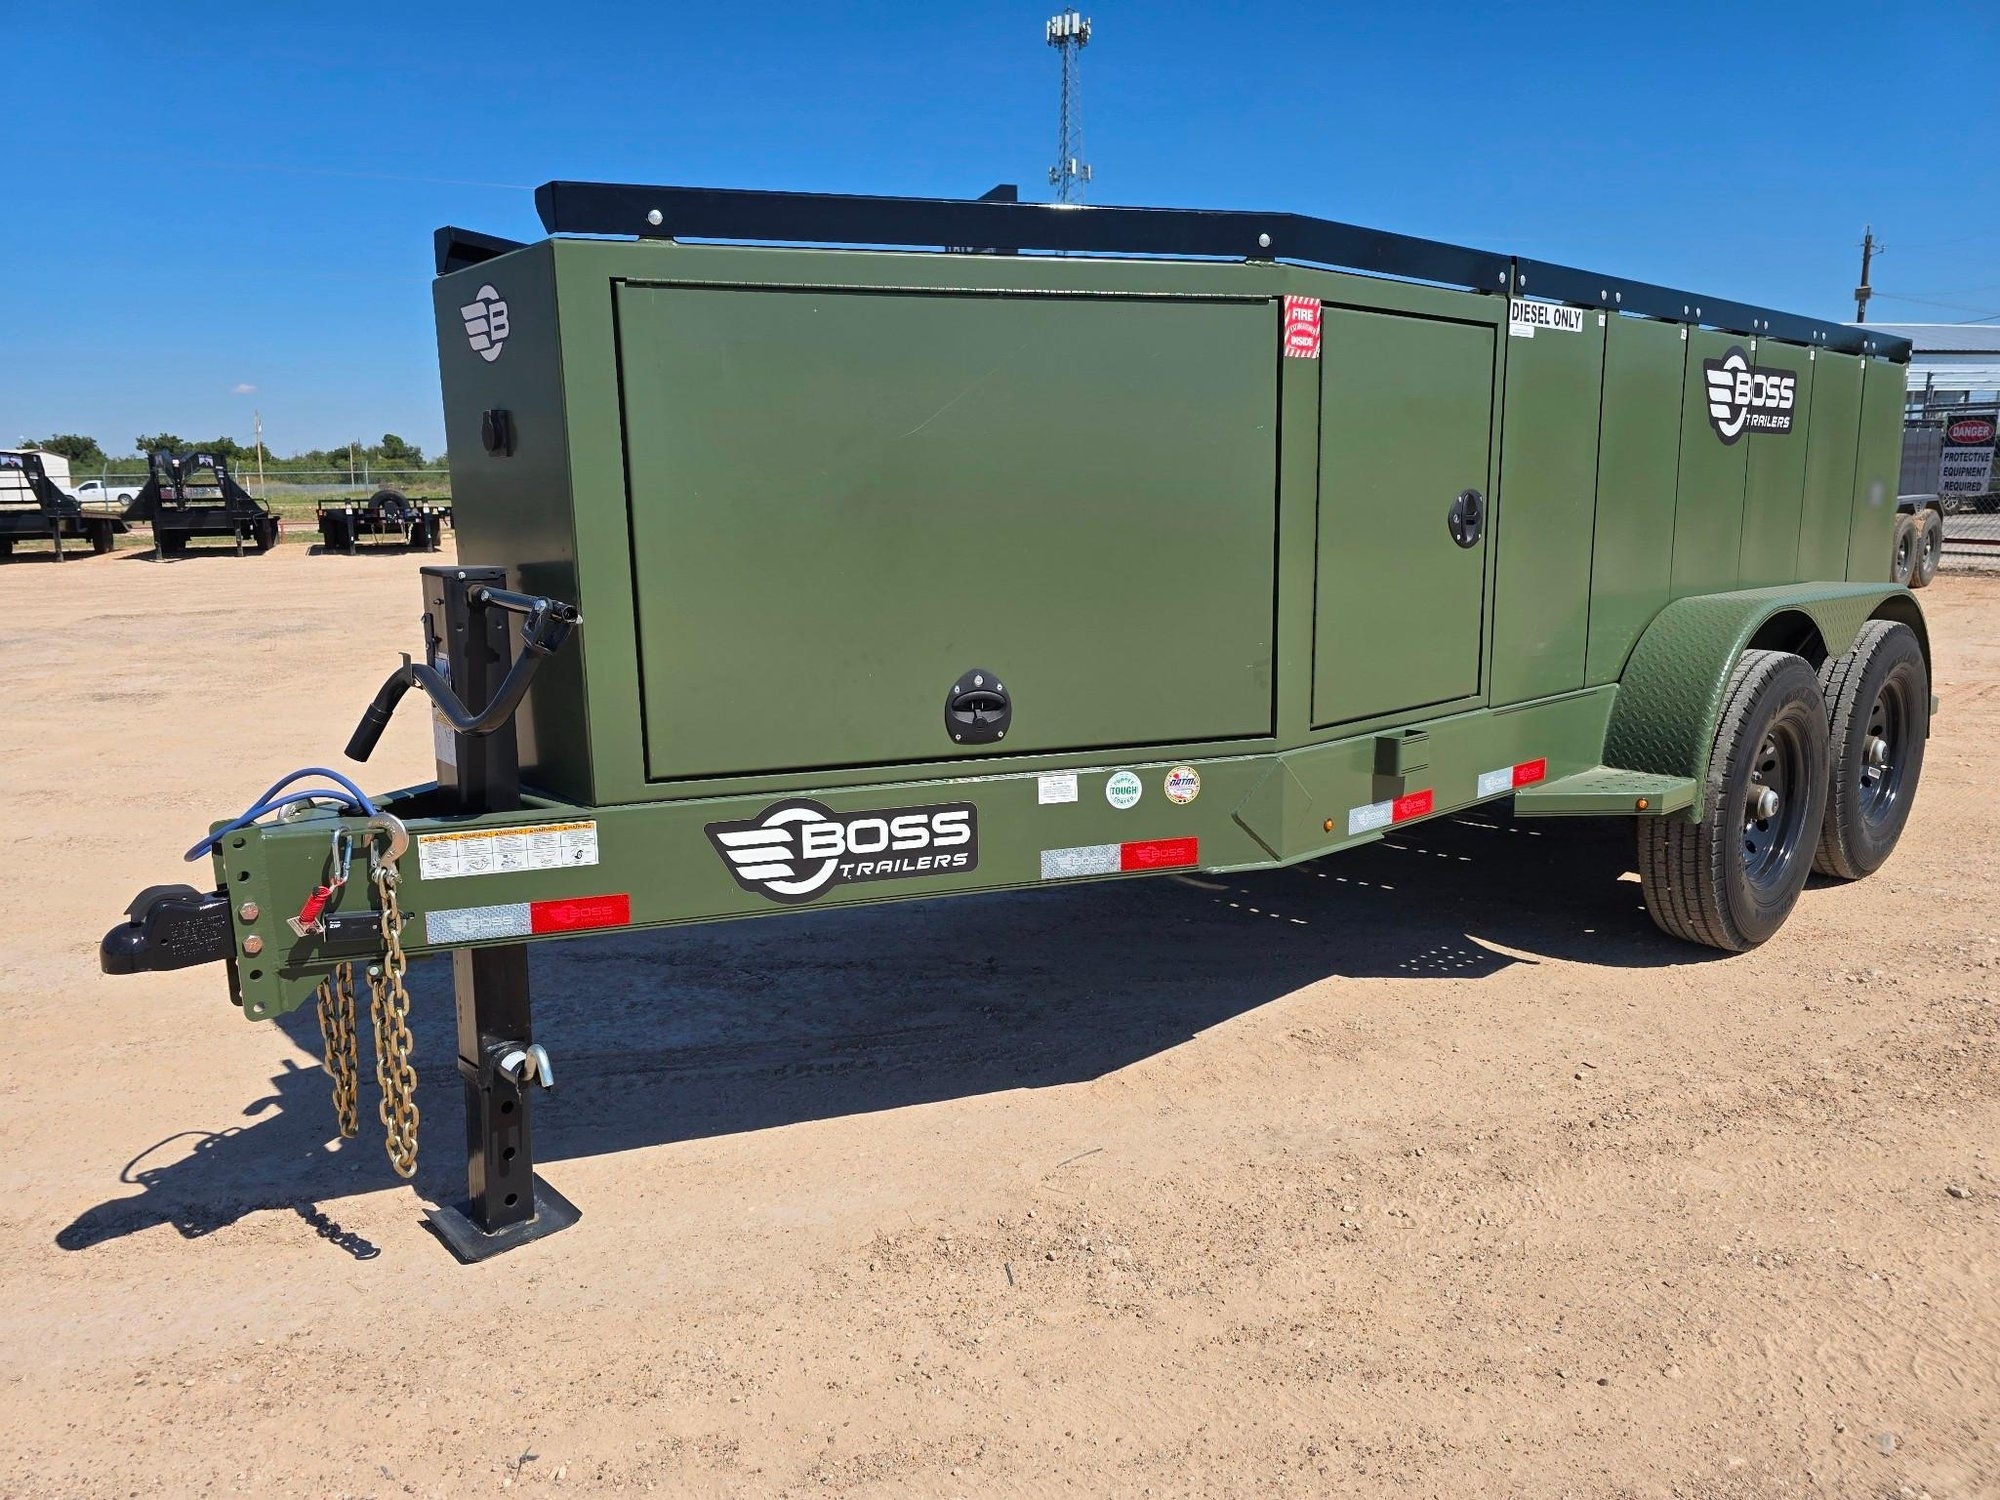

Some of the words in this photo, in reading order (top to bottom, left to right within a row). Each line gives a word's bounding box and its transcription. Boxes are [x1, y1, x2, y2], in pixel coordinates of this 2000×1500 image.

[1293, 308, 1314, 321] FIRE
[1511, 302, 1550, 325] DIESEL
[1554, 308, 1581, 329] ONLY
[1734, 372, 1795, 409] BOSS
[1746, 414, 1791, 428] TRAILERS
[1952, 425, 1990, 437] DANGER
[1943, 452, 1991, 463] PROTECTIVE
[1943, 466, 1987, 477] EQUIPMENT
[1943, 481, 1982, 492] REQUIRED
[1111, 785, 1137, 795] TOUGH
[802, 810, 971, 859] BOSS
[839, 852, 968, 877] TRAILERS
[569, 906, 612, 919] BOSS
